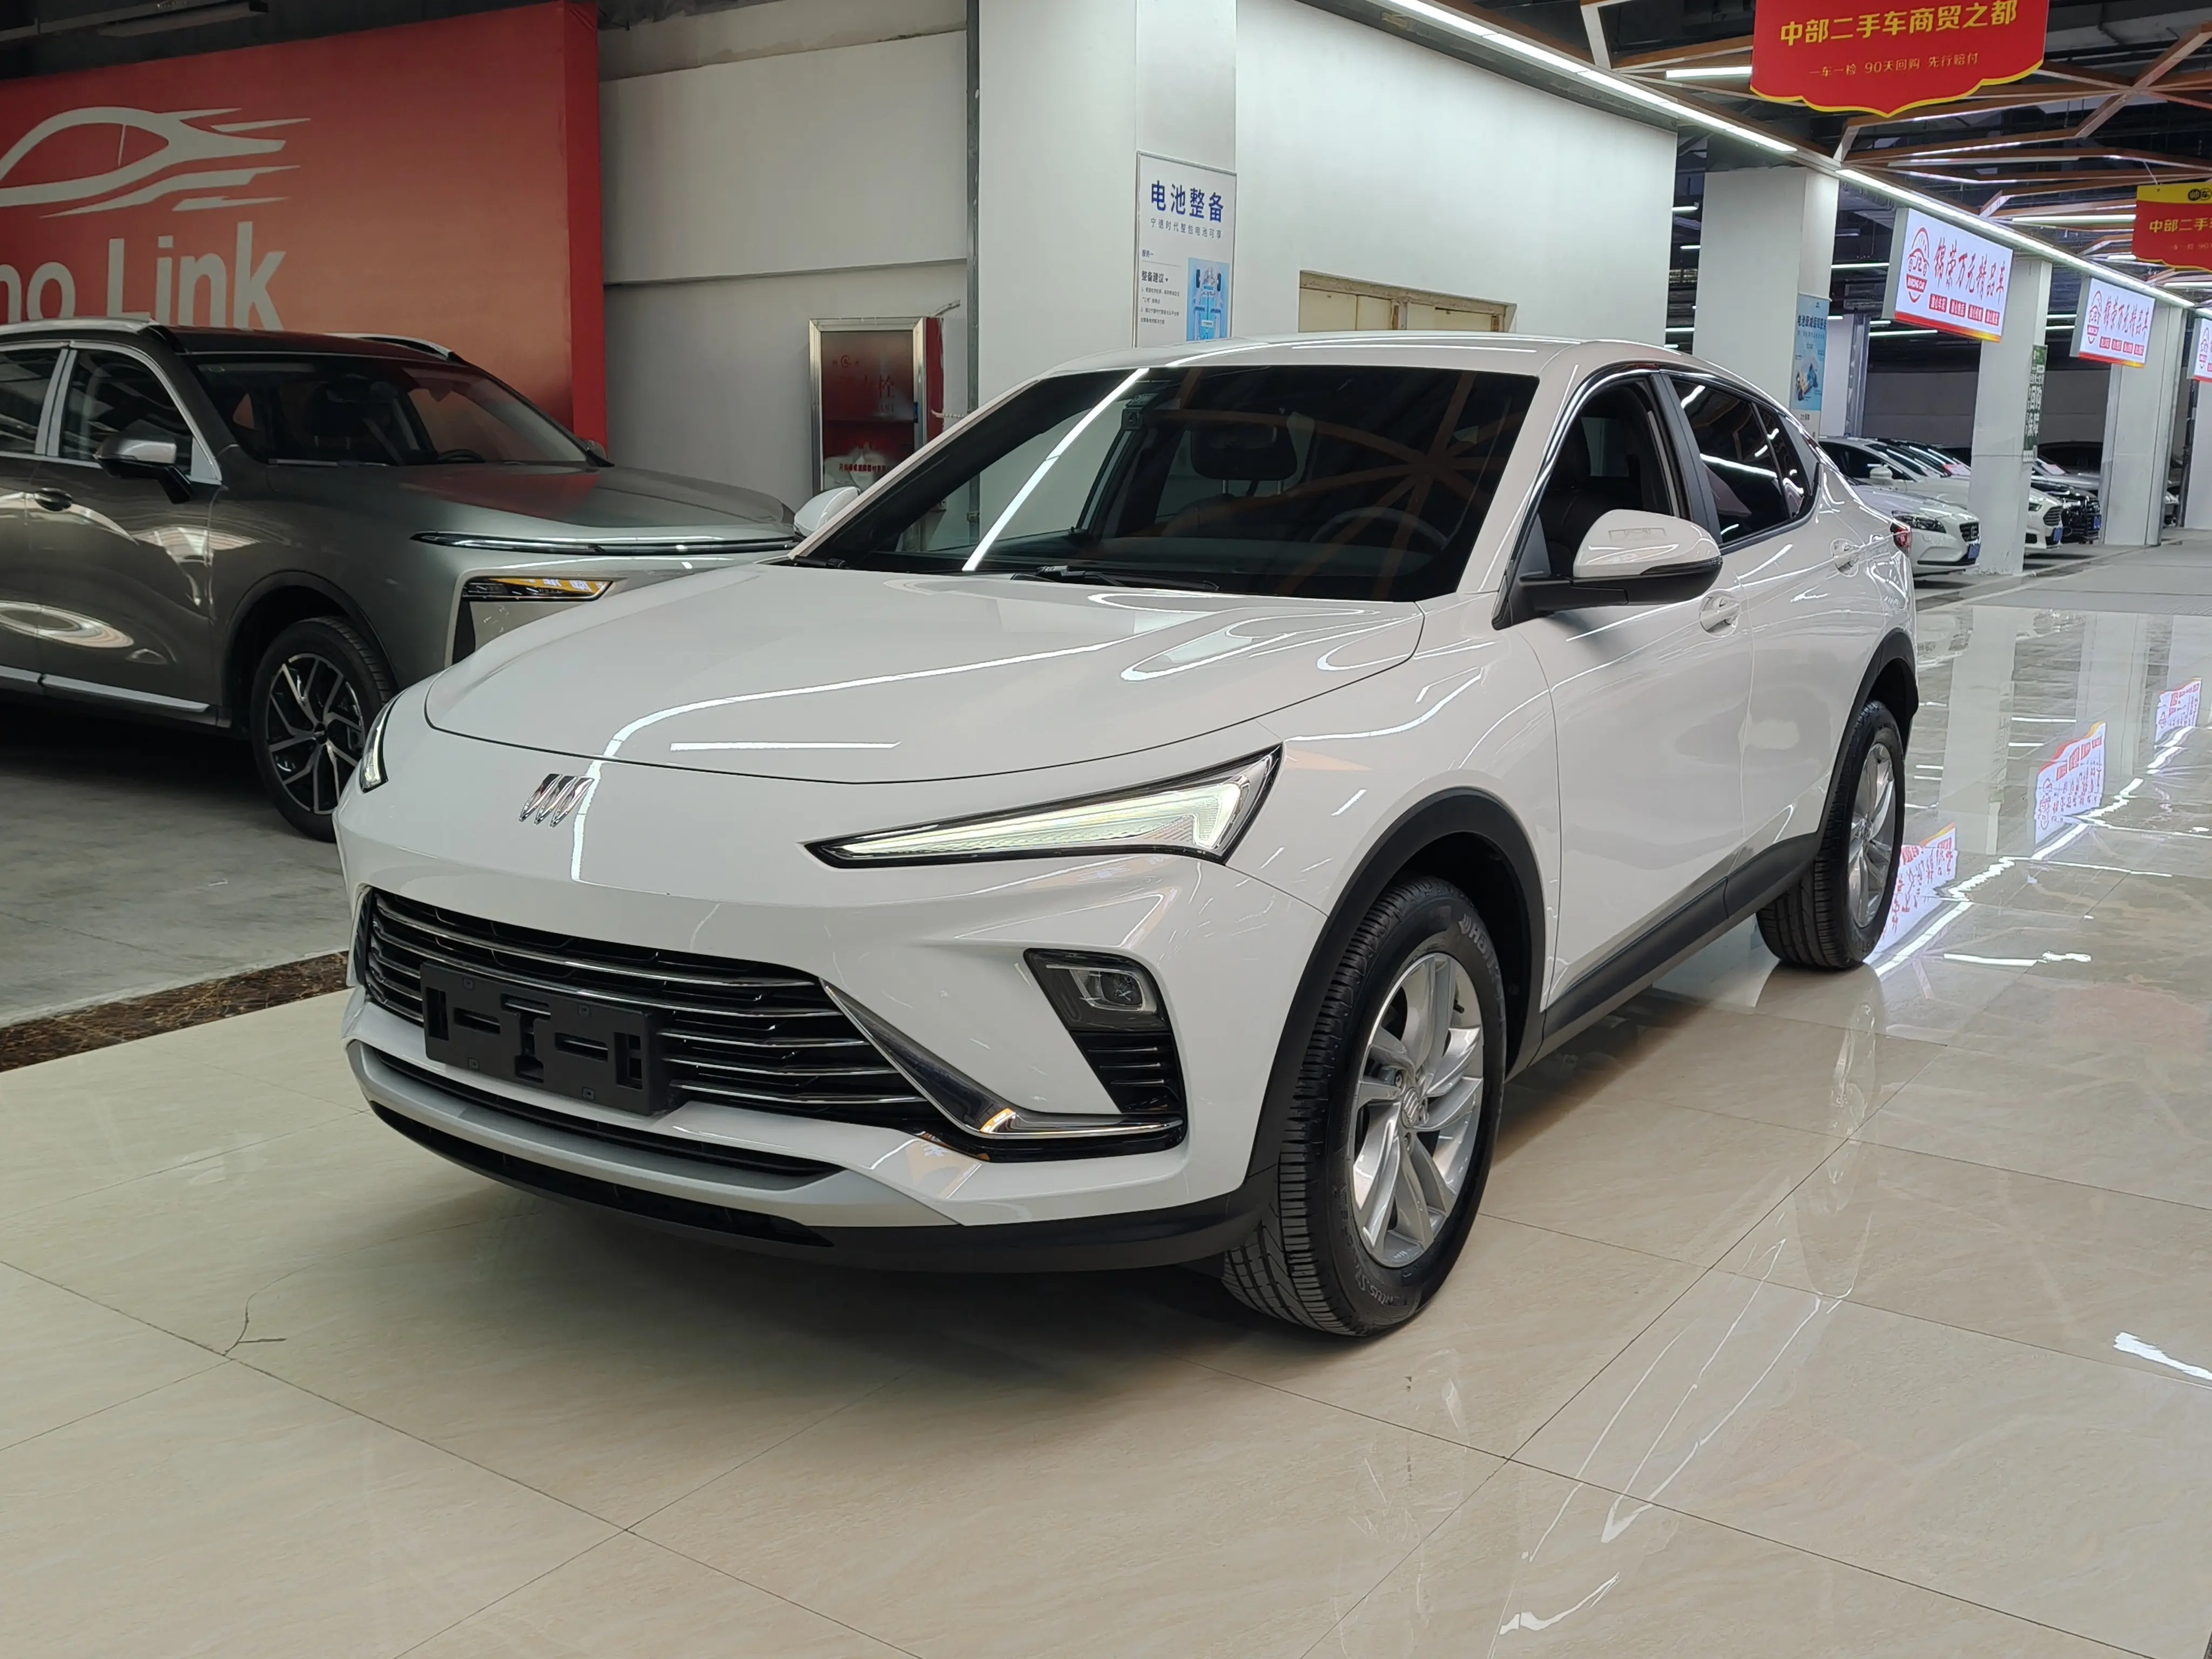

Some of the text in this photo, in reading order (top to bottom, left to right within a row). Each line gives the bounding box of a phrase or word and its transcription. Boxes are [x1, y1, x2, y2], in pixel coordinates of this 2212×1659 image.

[1780, 0, 2018, 46] 中部二手车商贸之都
[1809, 52, 1979, 78] 一车一检 90天回购 先行赔付
[1151, 180, 1224, 222] 电池整备
[2149, 217, 2212, 233] 中部二手
[107, 221, 286, 331] Link
